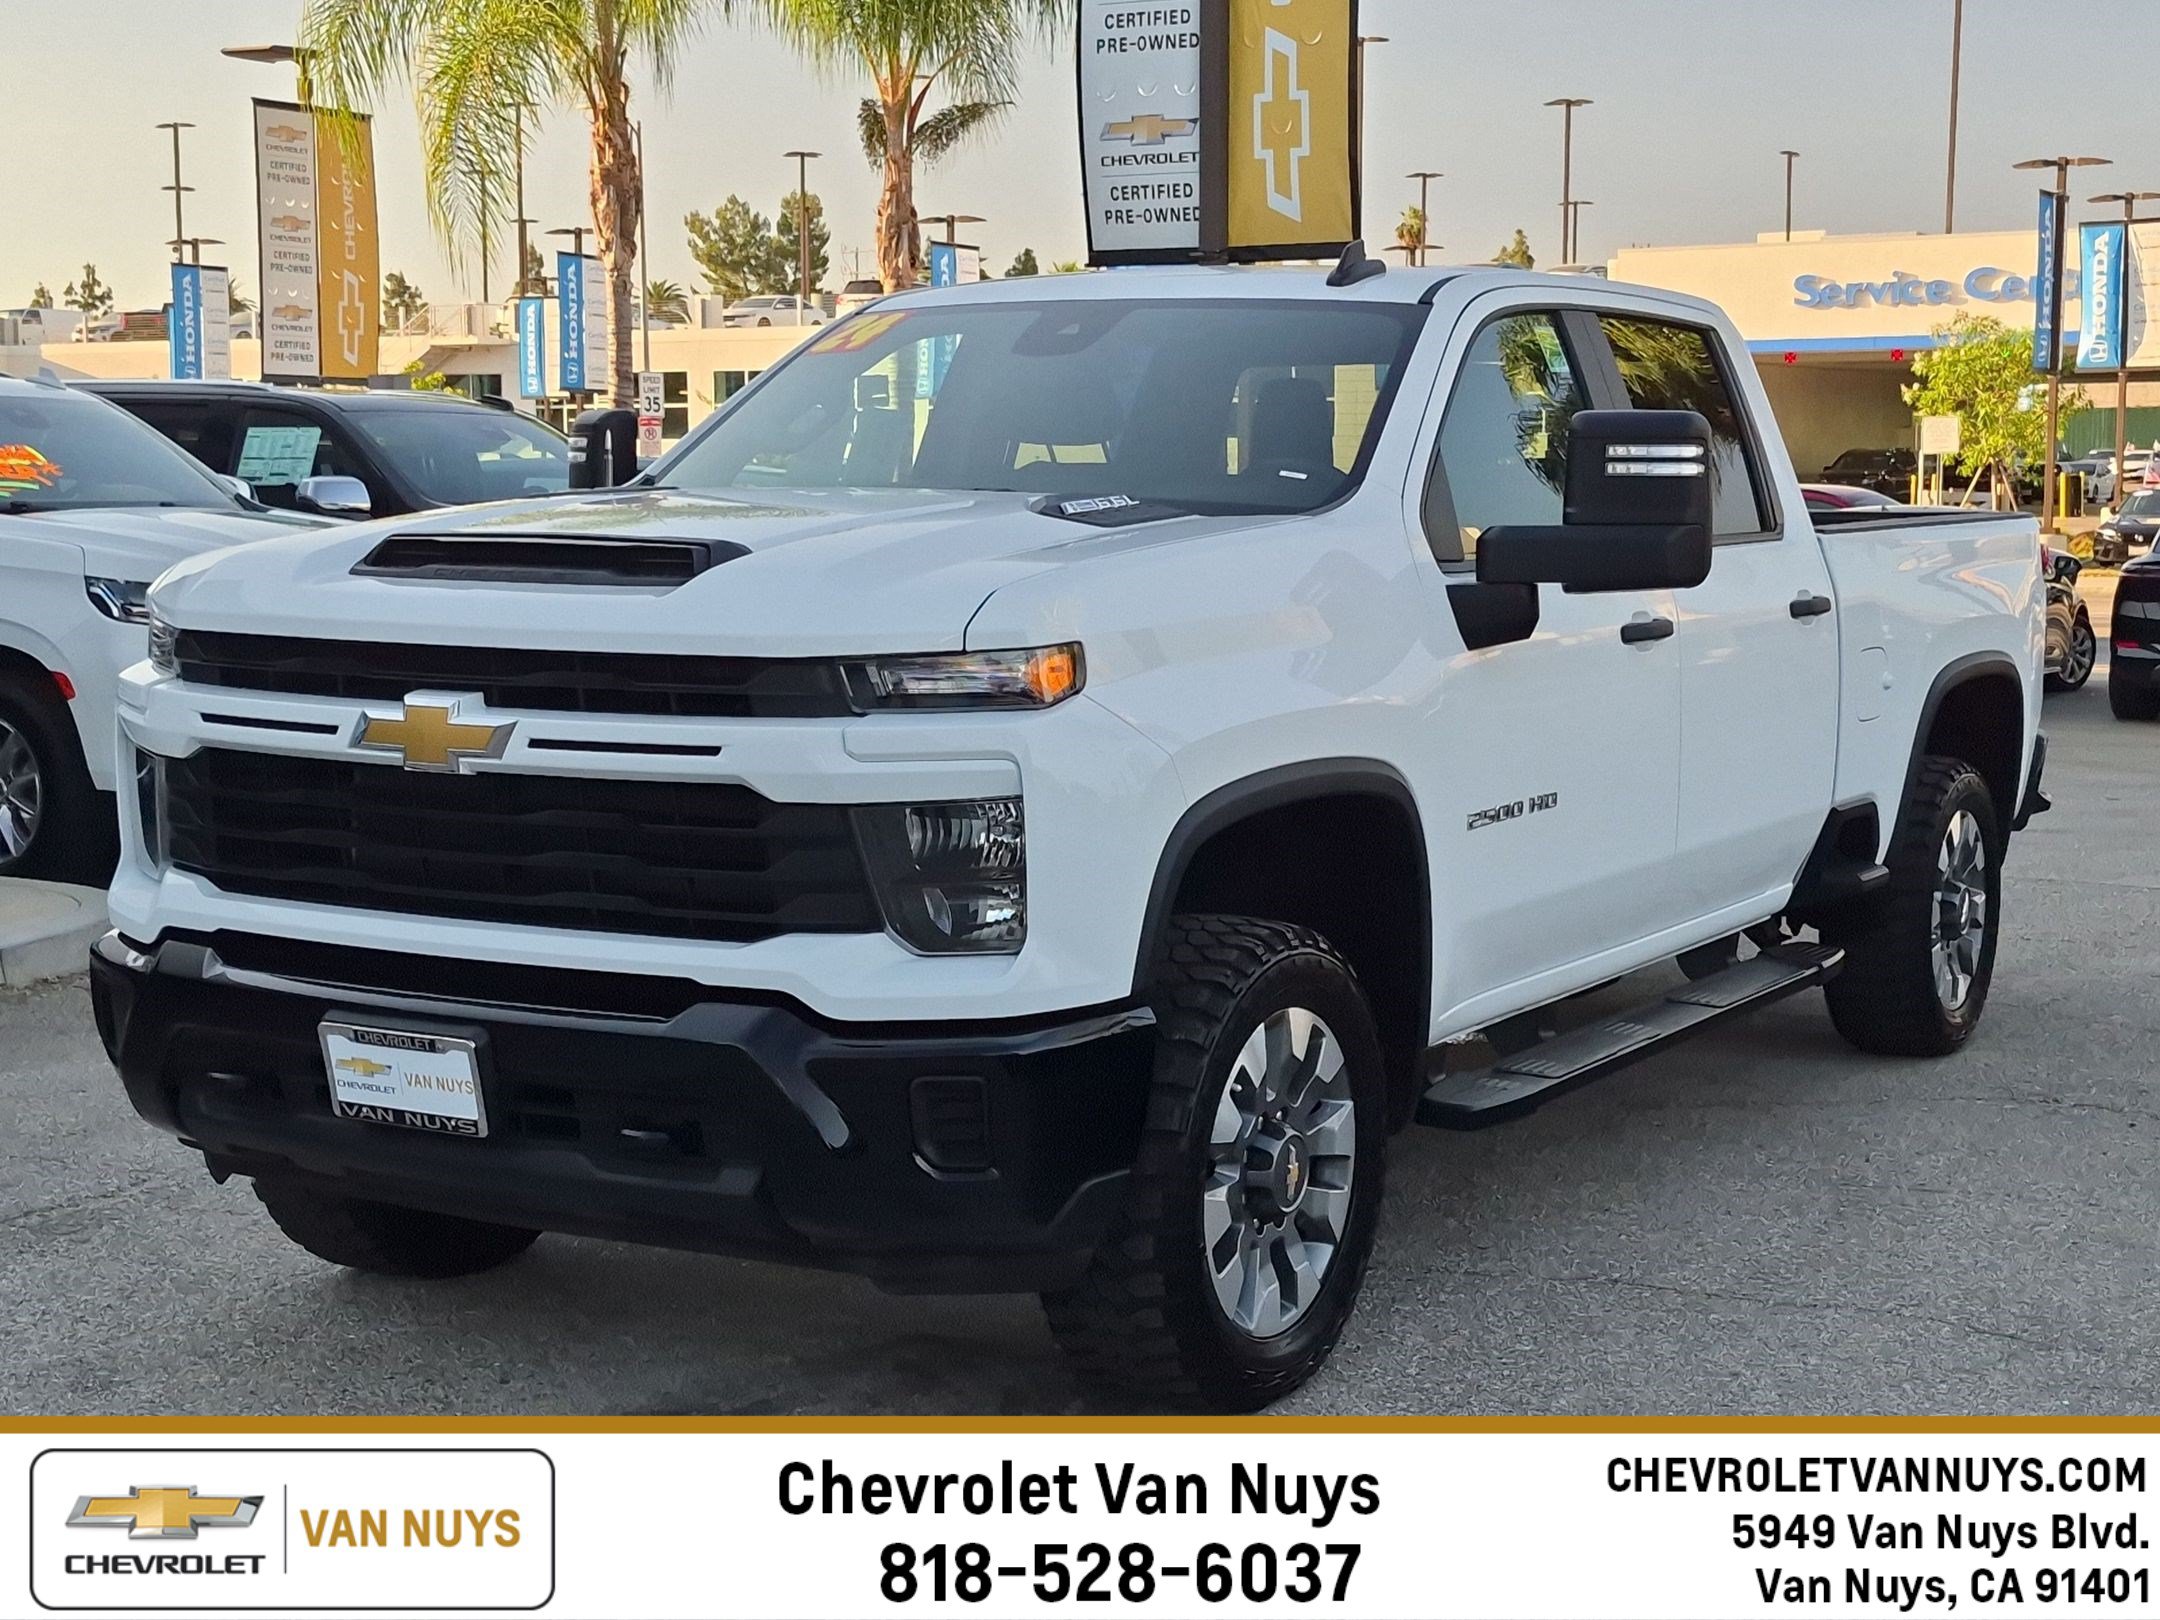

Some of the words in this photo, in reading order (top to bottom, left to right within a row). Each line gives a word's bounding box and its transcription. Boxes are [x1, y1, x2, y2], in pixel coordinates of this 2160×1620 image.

[1104, 9, 1191, 30] CERTIFIED
[1096, 32, 1200, 54] PRE-OWNED
[265, 143, 309, 155] CHEVROLET
[269, 160, 307, 173] CERTIFIED
[1101, 151, 1200, 167] CHEVROLET
[266, 172, 311, 185] PRE-OWNED
[1110, 183, 1193, 202] CERTIFIED
[1104, 206, 1200, 225] PRE-OWNED
[269, 234, 312, 244] CHEVROLET
[273, 250, 311, 261] CERTIFIED
[270, 262, 313, 275] PRE-OWNED
[1793, 270, 1951, 307] Service
[2091, 230, 2110, 341] HONDA
[182, 273, 196, 363] HONDA
[567, 262, 579, 360] HONDA
[271, 323, 313, 333] CHEVROLET
[273, 339, 311, 351] CERTIFIED
[526, 303, 537, 376] HONDA
[270, 351, 314, 363] PRE-OWNED
[643, 376, 661, 384] SPEED
[643, 386, 661, 394] LIMIT
[644, 396, 661, 413] 35
[1466, 800, 1524, 831] 2500
[1528, 792, 1558, 815] HD
[357, 1031, 433, 1052] CHEVROLET
[337, 1079, 396, 1096] CHEVROLET
[404, 1072, 433, 1091] VAN
[436, 1076, 474, 1096] NUYS
[341, 1102, 395, 1123] VAN
[405, 1111, 478, 1135] NUYS
